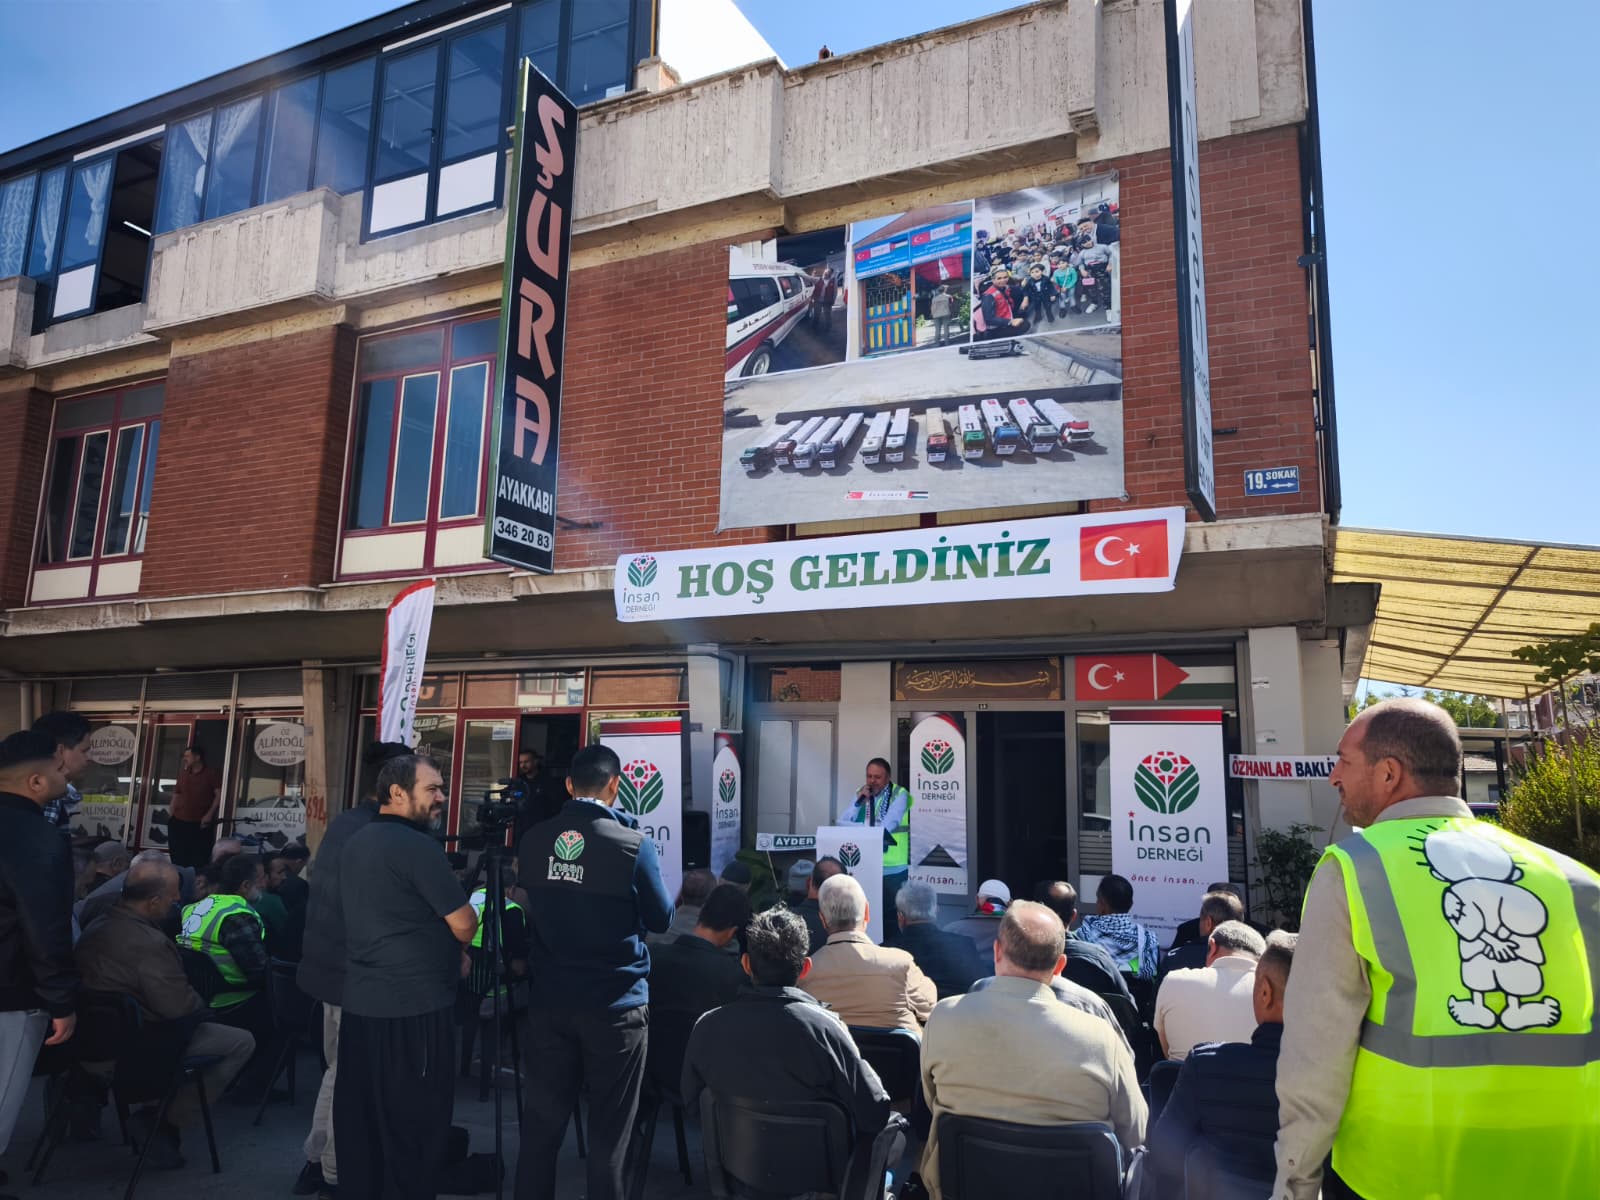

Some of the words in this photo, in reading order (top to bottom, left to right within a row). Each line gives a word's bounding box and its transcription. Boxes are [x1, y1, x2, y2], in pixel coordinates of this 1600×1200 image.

[513, 95, 565, 466] ŞURA
[1248, 472, 1267, 489] 19.
[1266, 469, 1296, 480] SOKAK
[498, 475, 552, 516] AYAKKABI
[497, 520, 518, 538] 346
[521, 528, 534, 543] 20
[537, 534, 550, 548] 83
[676, 558, 774, 604] HOŞ
[789, 530, 1051, 591] GELDİNİZ
[258, 735, 304, 749] ALİMOĞL
[1232, 755, 1293, 776] ÖZHANLAR
[775, 838, 814, 847] AYDER
[1137, 846, 1203, 862] DERNEĞİ
[1131, 873, 1156, 882] önce
